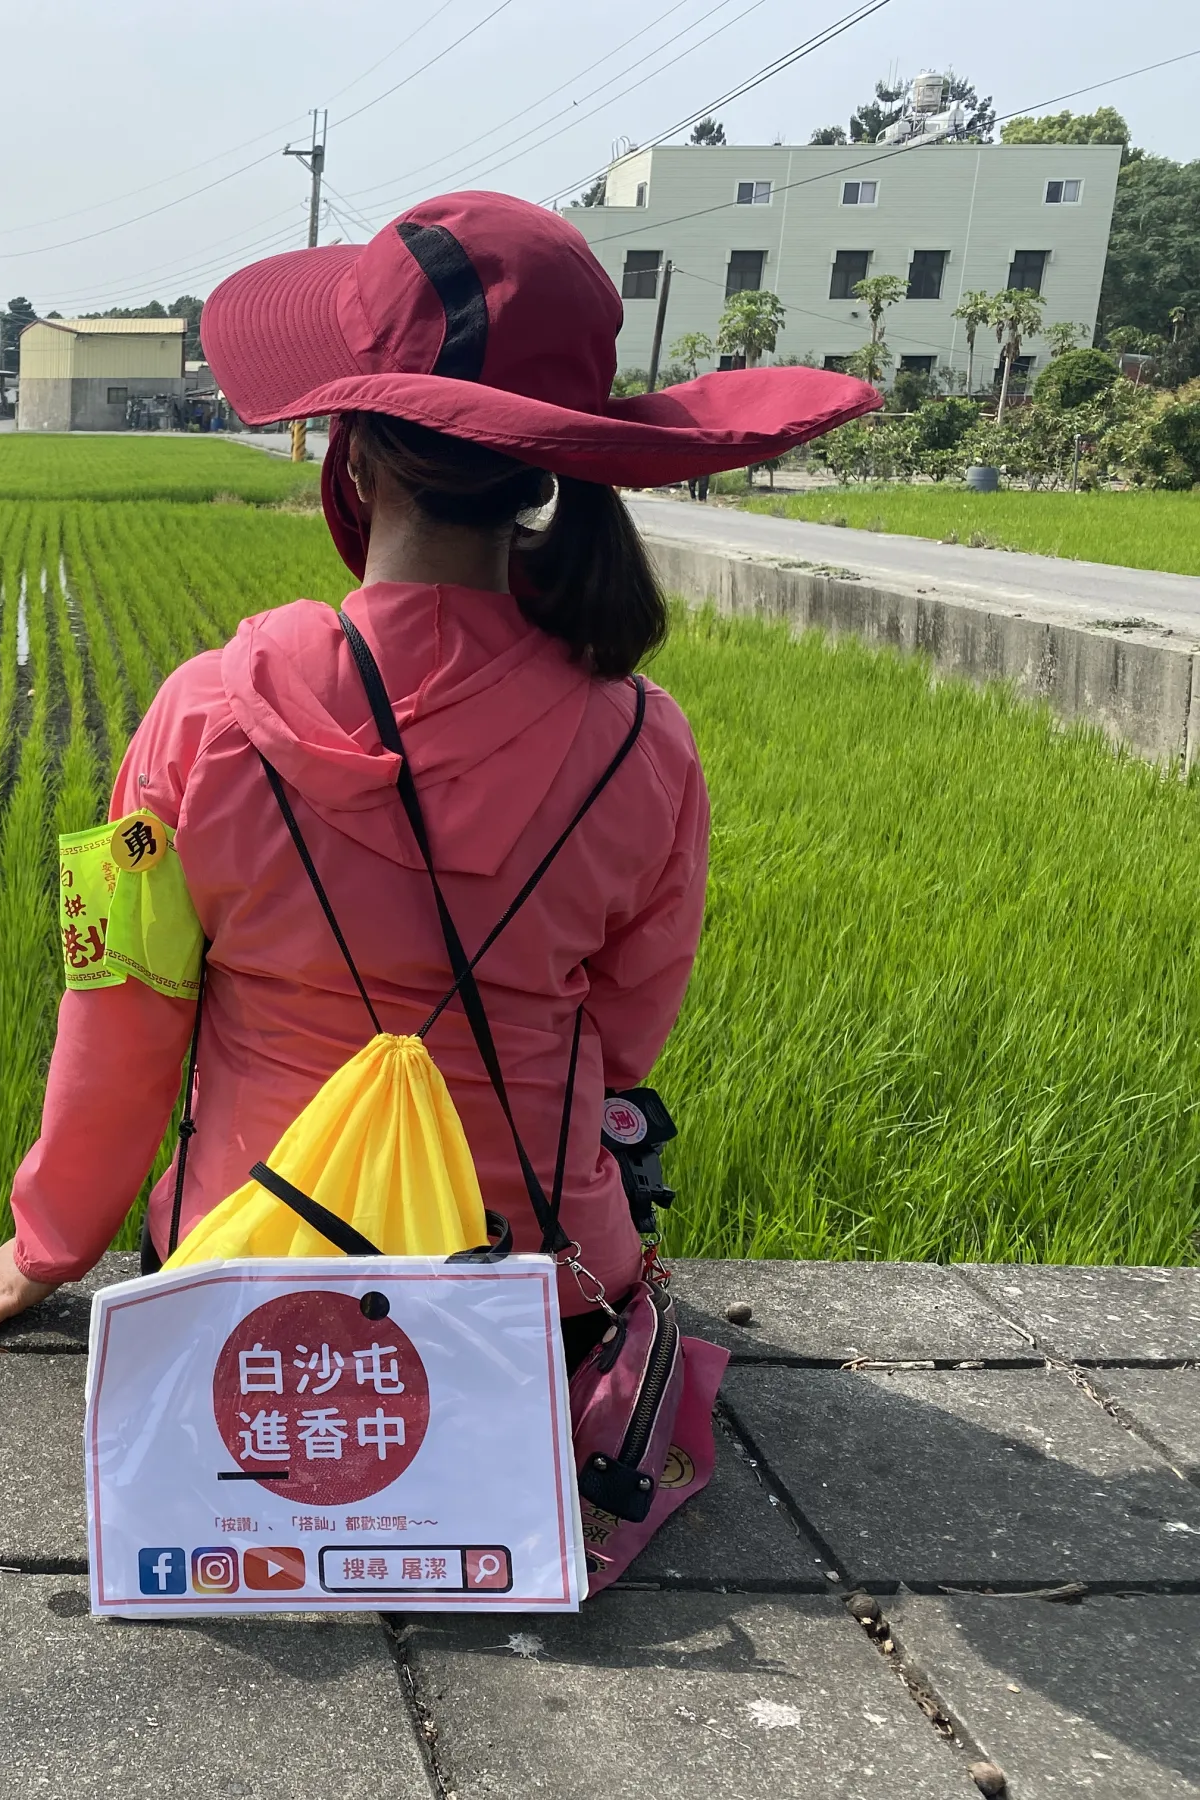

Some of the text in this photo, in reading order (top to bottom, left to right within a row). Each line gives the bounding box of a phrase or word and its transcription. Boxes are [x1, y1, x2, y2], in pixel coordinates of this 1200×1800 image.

[121, 820, 157, 868] 勇
[238, 1341, 406, 1396] 白沙屯
[238, 1407, 406, 1462] 進香中
[342, 1557, 448, 1580] 搜尋 屠潔
